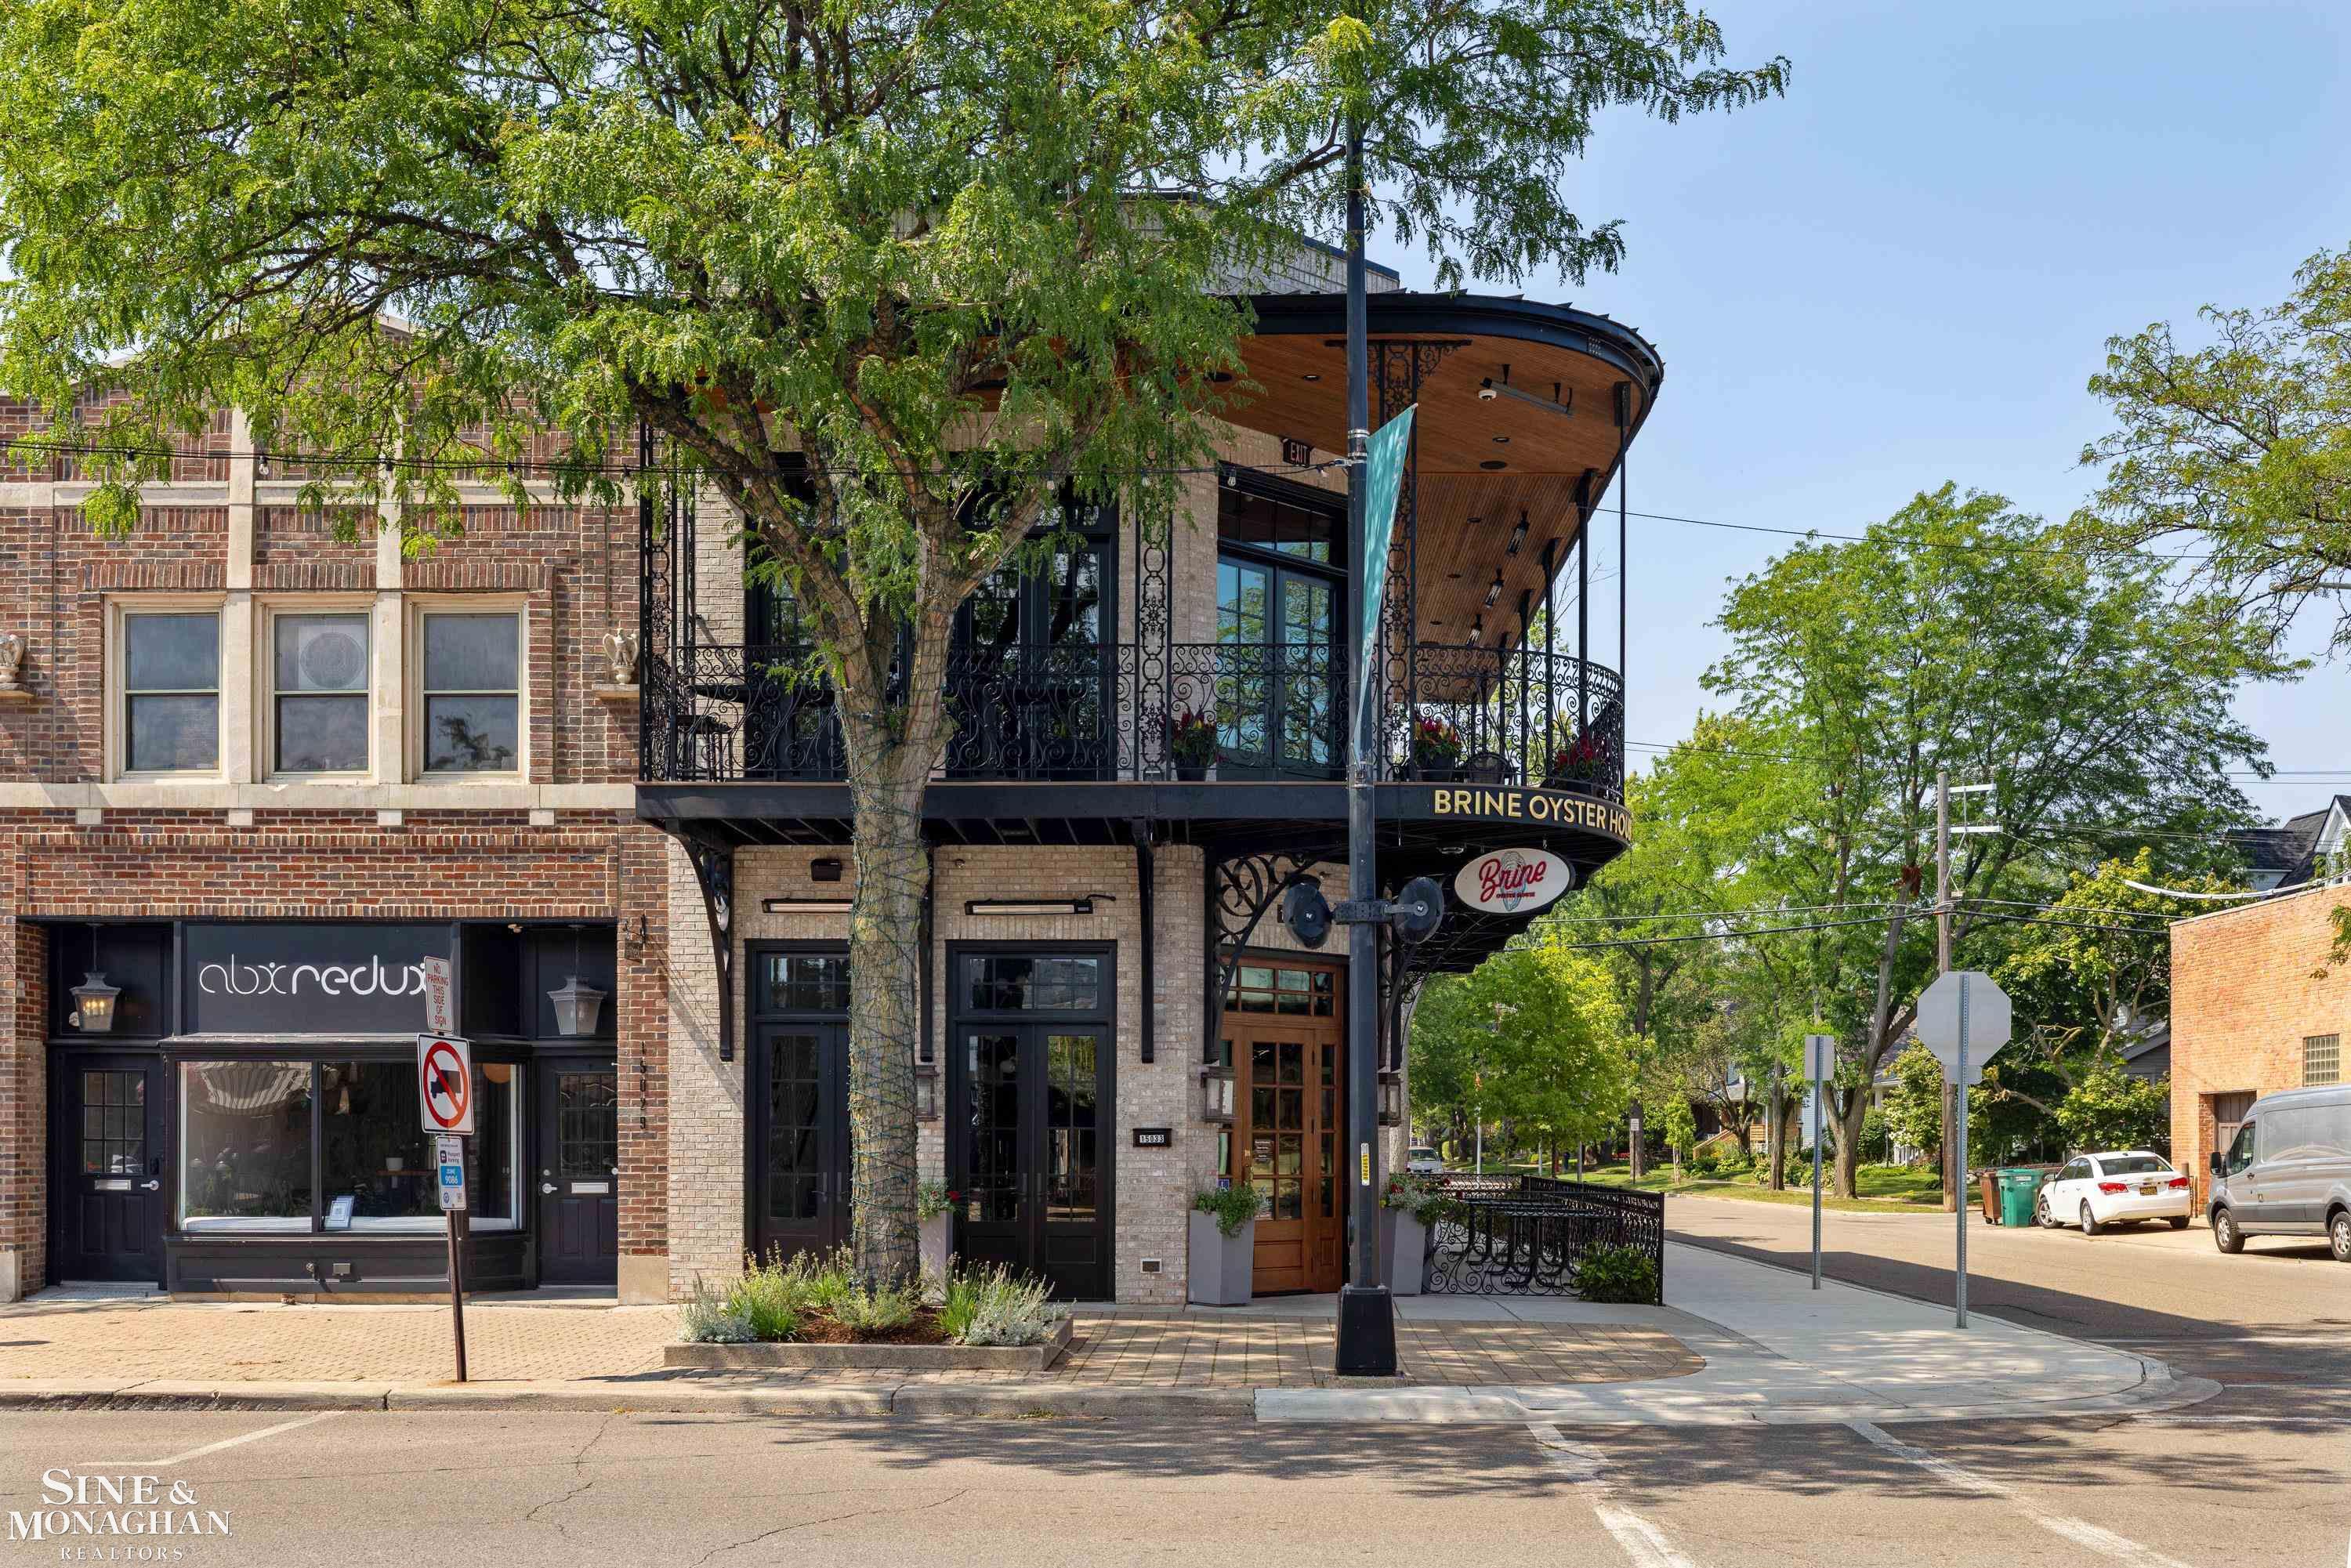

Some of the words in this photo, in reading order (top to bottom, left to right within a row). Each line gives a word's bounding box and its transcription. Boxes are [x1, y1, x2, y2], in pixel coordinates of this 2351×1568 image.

[1291, 442, 1308, 464] EXIT
[1434, 789, 1522, 817] BRINE
[1529, 795, 1607, 829] OYSTER
[1479, 858, 1547, 903] Brine
[433, 964, 442, 975] NO
[427, 973, 449, 986] PARKING
[433, 985, 445, 995] THIS
[433, 994, 445, 1005] SIDE
[436, 1005, 444, 1014] OF
[434, 1015, 447, 1026] SIGN
